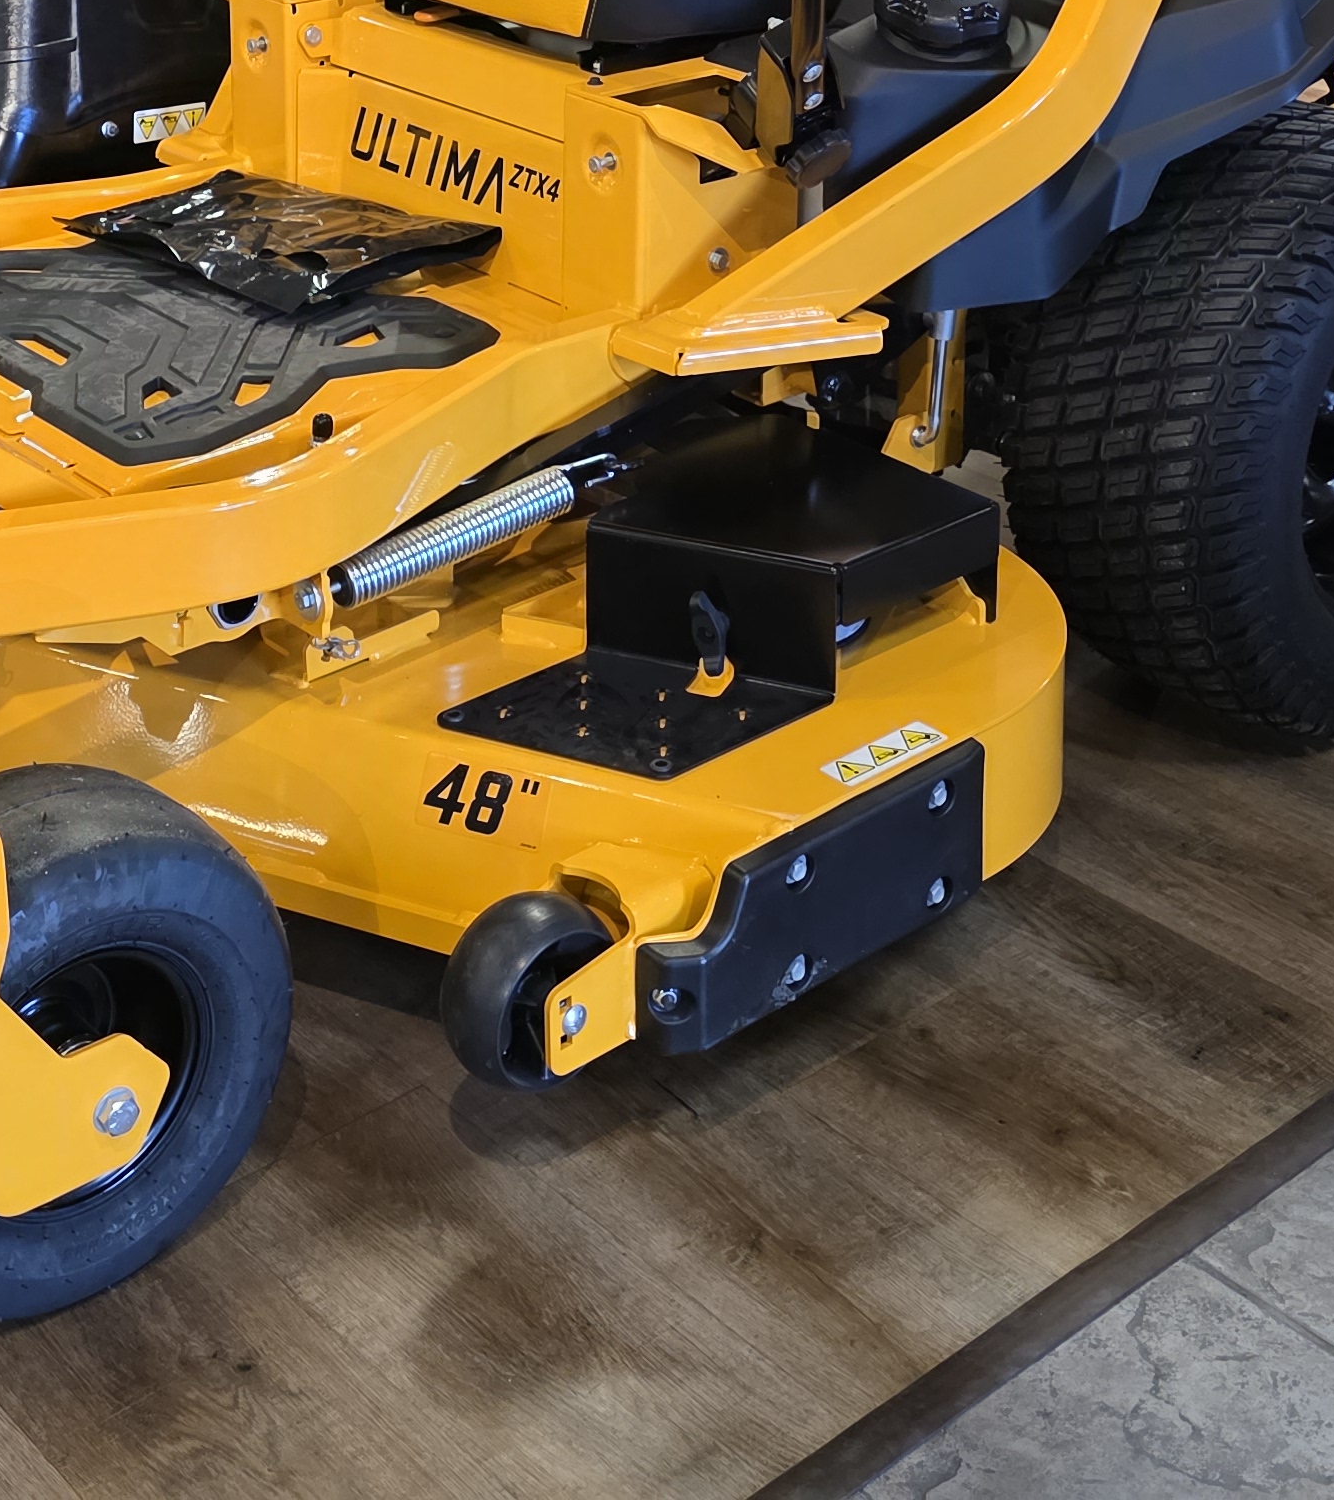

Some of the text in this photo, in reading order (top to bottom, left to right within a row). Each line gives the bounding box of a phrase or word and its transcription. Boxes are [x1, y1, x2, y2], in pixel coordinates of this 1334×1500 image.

[351, 106, 561, 214] ULTIMA ZTX4
[423, 763, 540, 835] 48"
